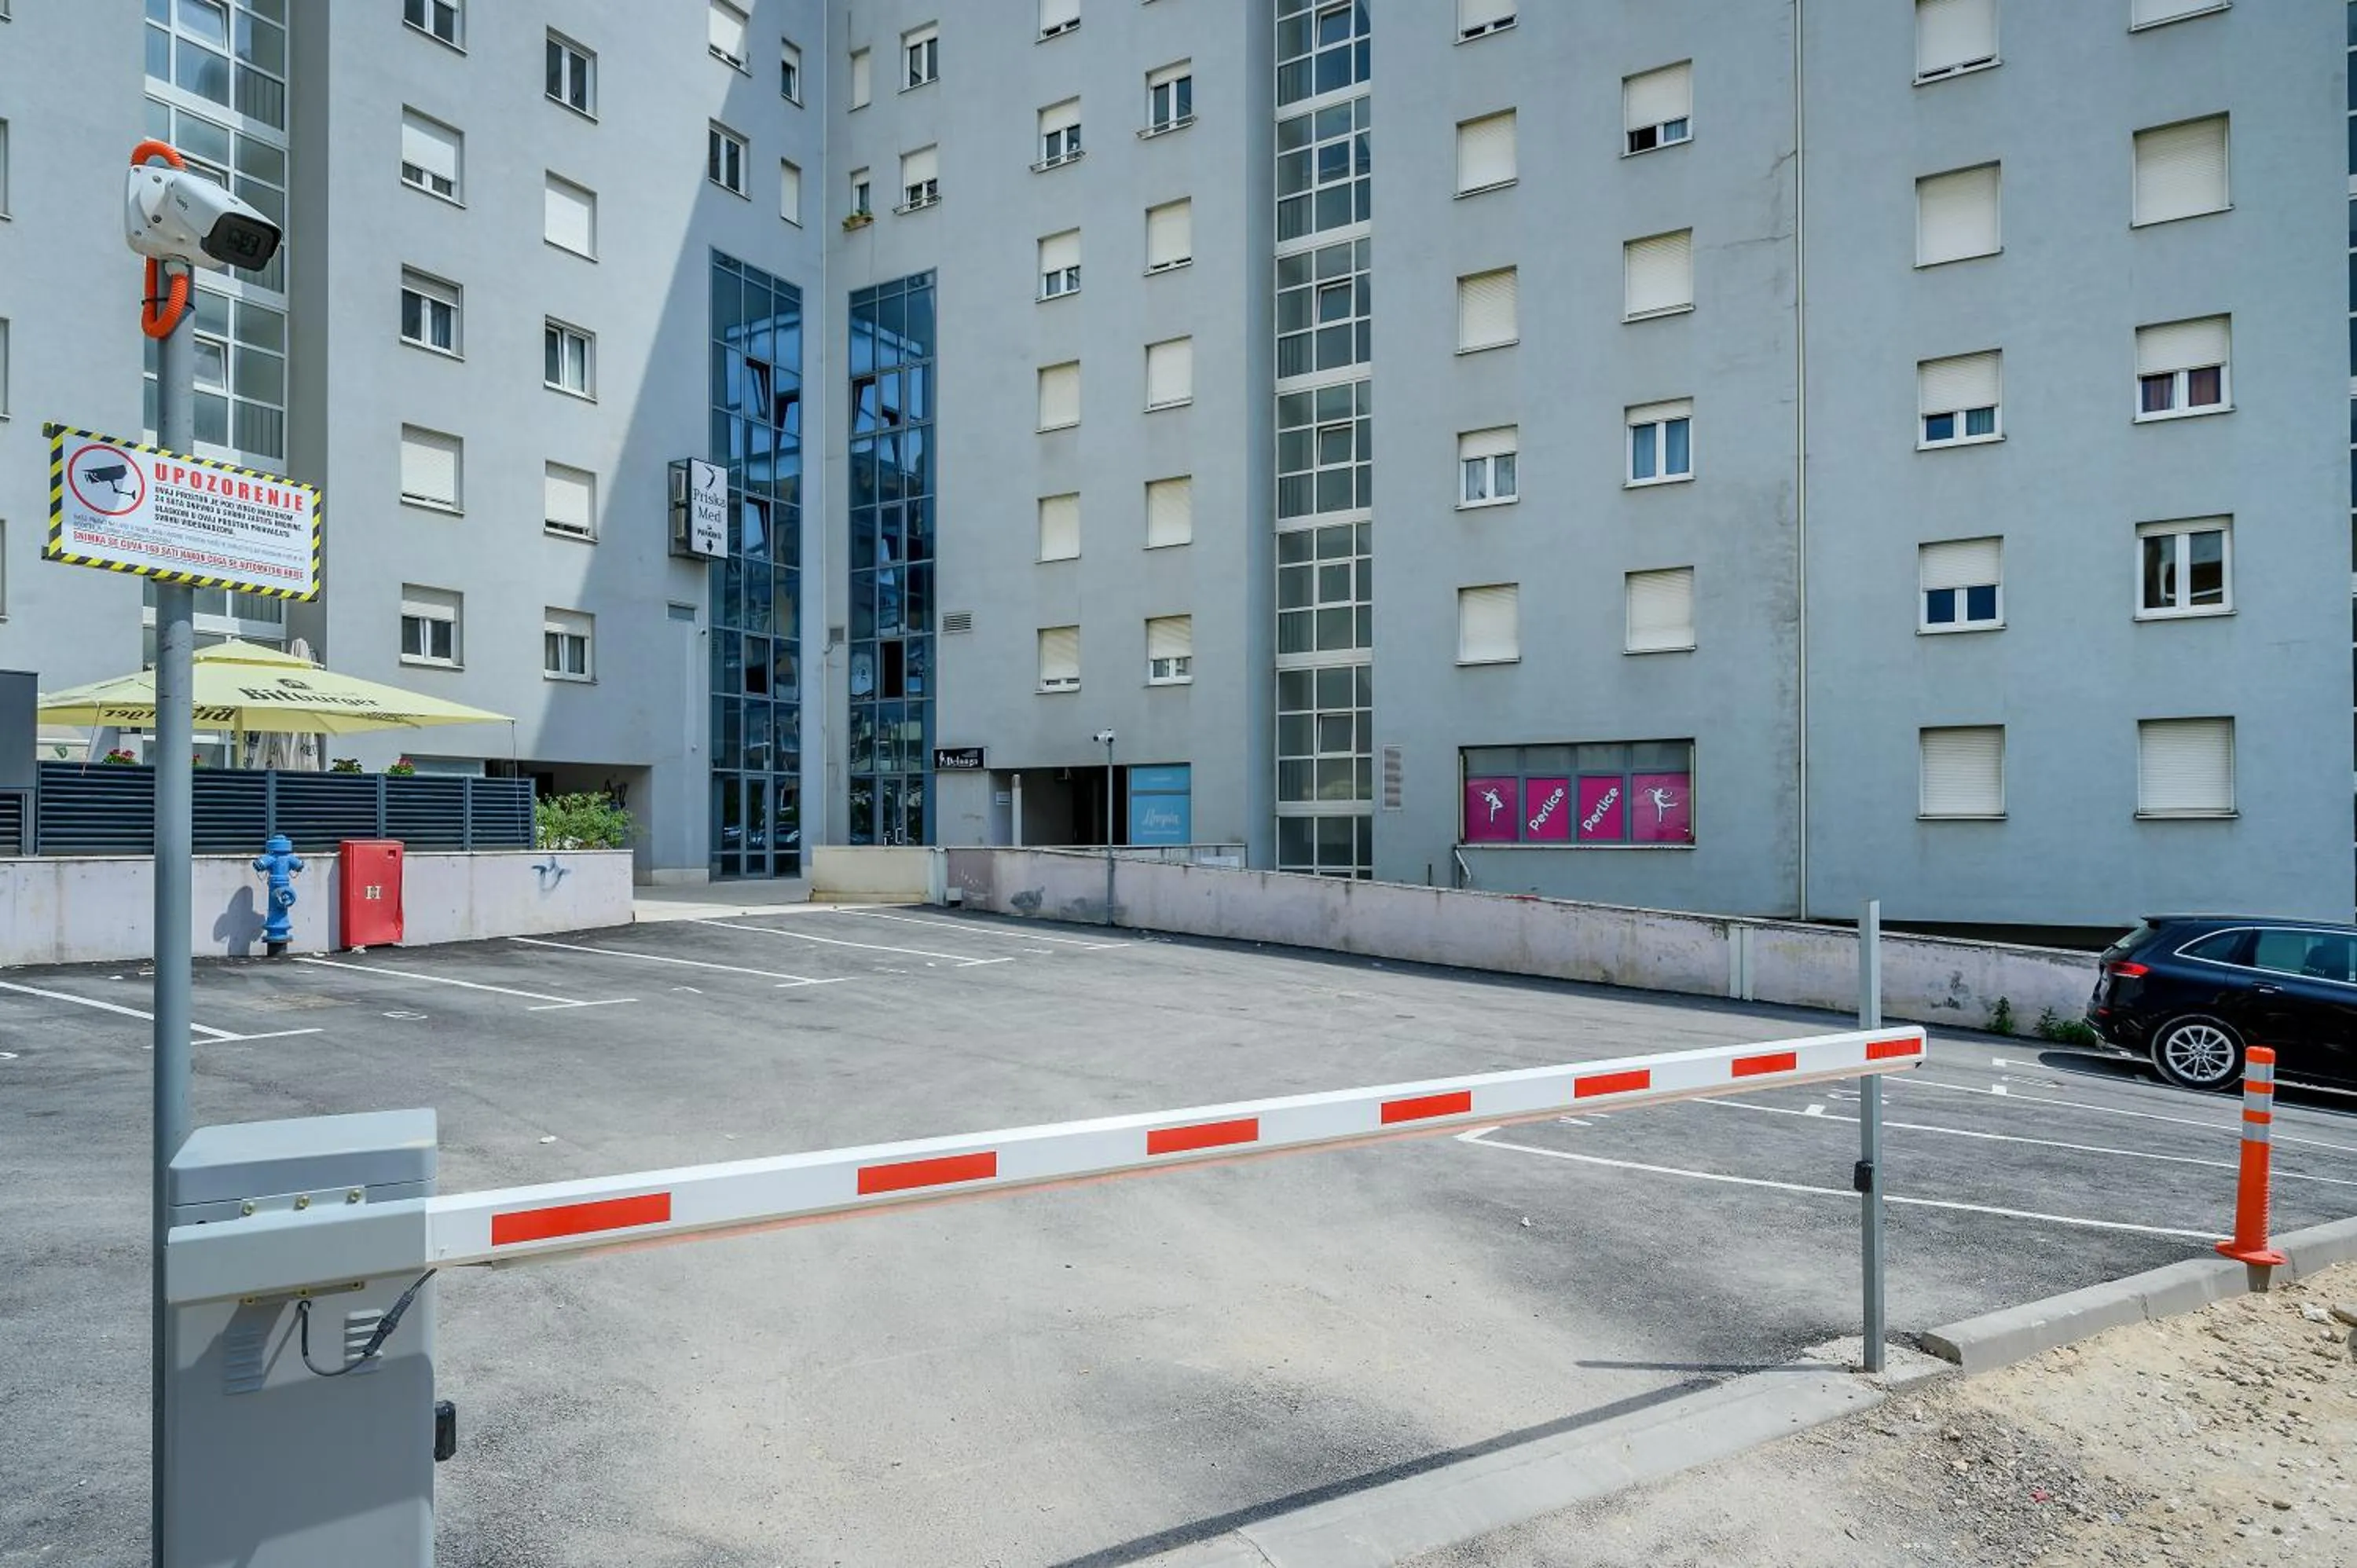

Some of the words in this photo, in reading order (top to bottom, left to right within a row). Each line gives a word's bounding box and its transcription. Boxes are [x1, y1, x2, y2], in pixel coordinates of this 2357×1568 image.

[155, 462, 303, 511] UPOZORENJE
[692, 488, 727, 507] Priska
[698, 505, 722, 524] Med
[238, 687, 379, 706] Bitburger
[1529, 788, 1564, 830] Perlice
[1582, 787, 1618, 831] Perlice
